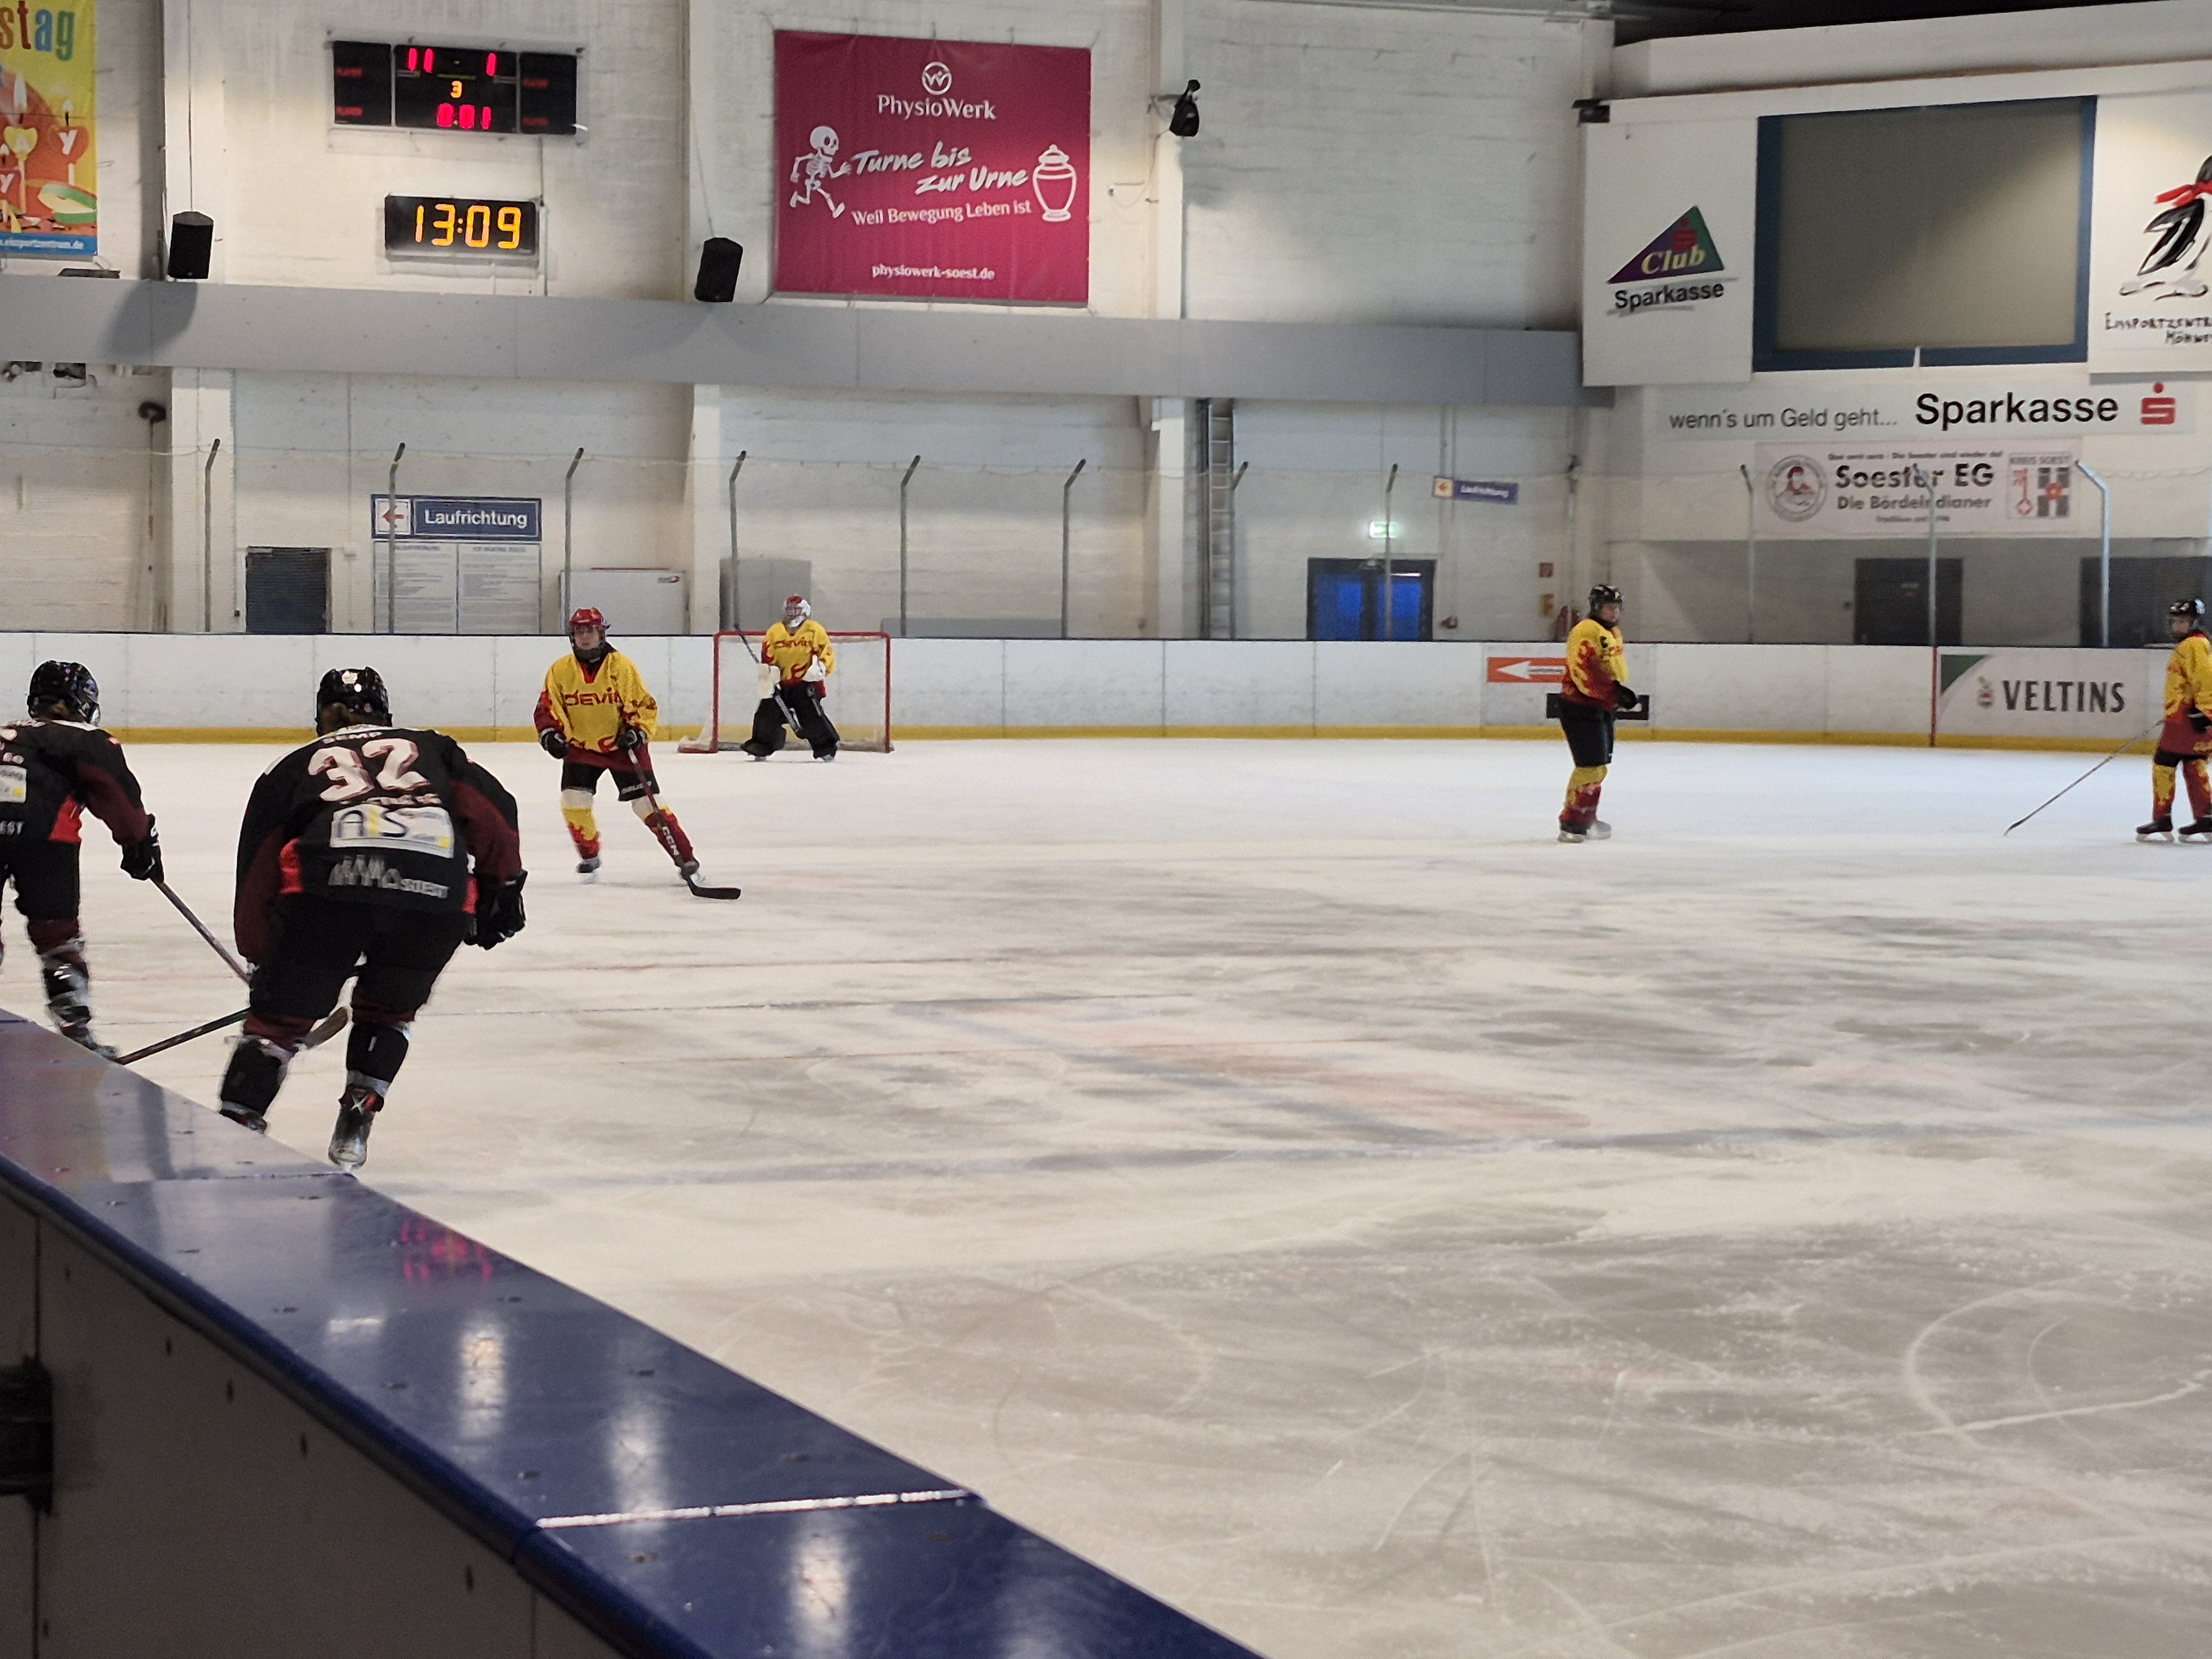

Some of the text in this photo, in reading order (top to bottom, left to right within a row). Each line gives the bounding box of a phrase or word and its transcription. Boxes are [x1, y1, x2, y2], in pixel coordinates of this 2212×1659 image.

[450, 81, 463, 98] 3
[878, 95, 996, 120] PhysioWerk
[853, 142, 972, 175] Turne bis
[915, 166, 1029, 195] zur Urne
[851, 200, 1031, 225] Weil Bewegung Leben ist
[415, 204, 521, 249] 13:09
[872, 265, 995, 280] physiowerk-soest.de
[1641, 245, 1706, 274] Club
[1615, 283, 1724, 312] Sparkasse
[1744, 412, 1775, 427] um
[1781, 408, 1827, 427] Geld
[1834, 408, 1897, 431] geht...
[1916, 392, 2119, 431] Sparkasse
[1835, 463, 1994, 488] Soester EG
[1837, 495, 1864, 510] Die
[425, 509, 527, 528] Laufrichtung
[2002, 680, 2125, 713] VELTINS
[307, 738, 431, 801] 32
